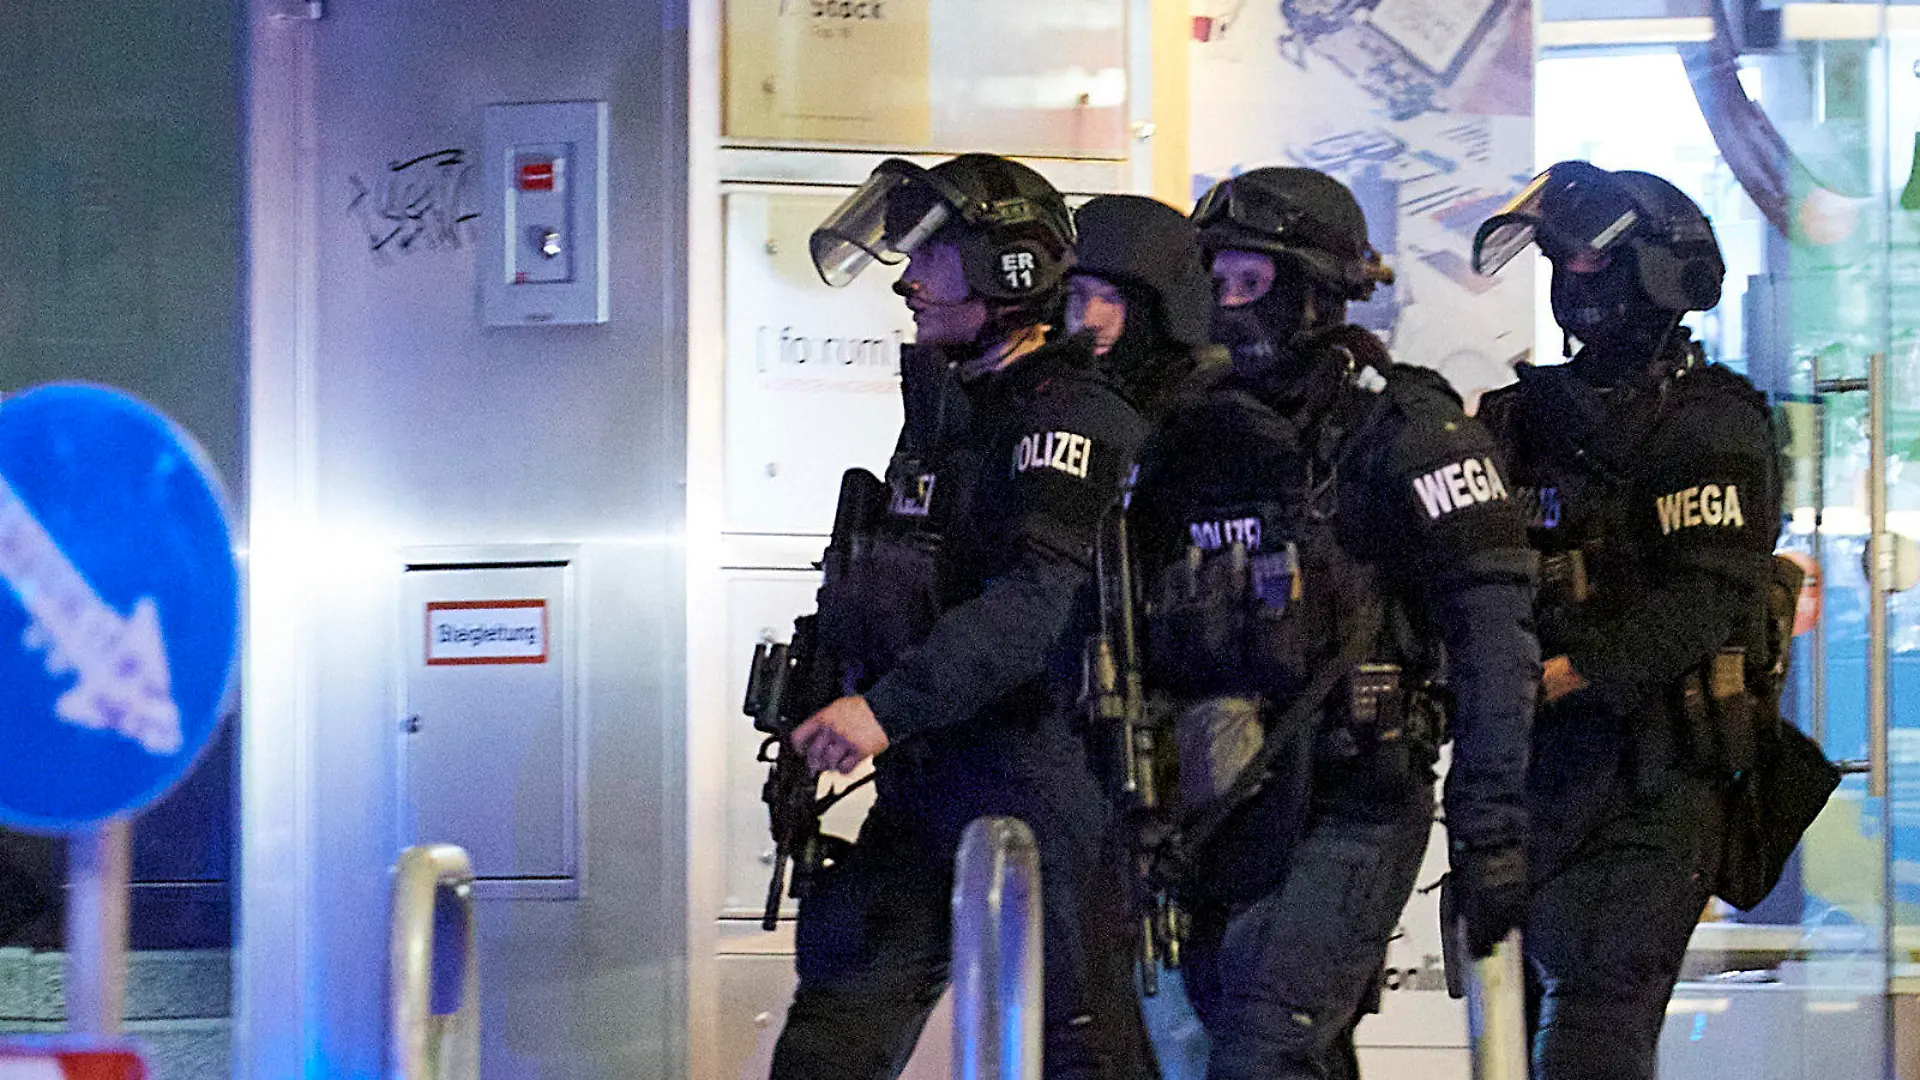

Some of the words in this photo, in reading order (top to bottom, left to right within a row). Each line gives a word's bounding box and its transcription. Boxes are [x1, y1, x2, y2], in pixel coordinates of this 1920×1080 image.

[1001, 252, 1034, 271] ER
[1006, 269, 1032, 288] 11
[1413, 457, 1508, 518] WEGA
[1656, 484, 1744, 536] WEGA
